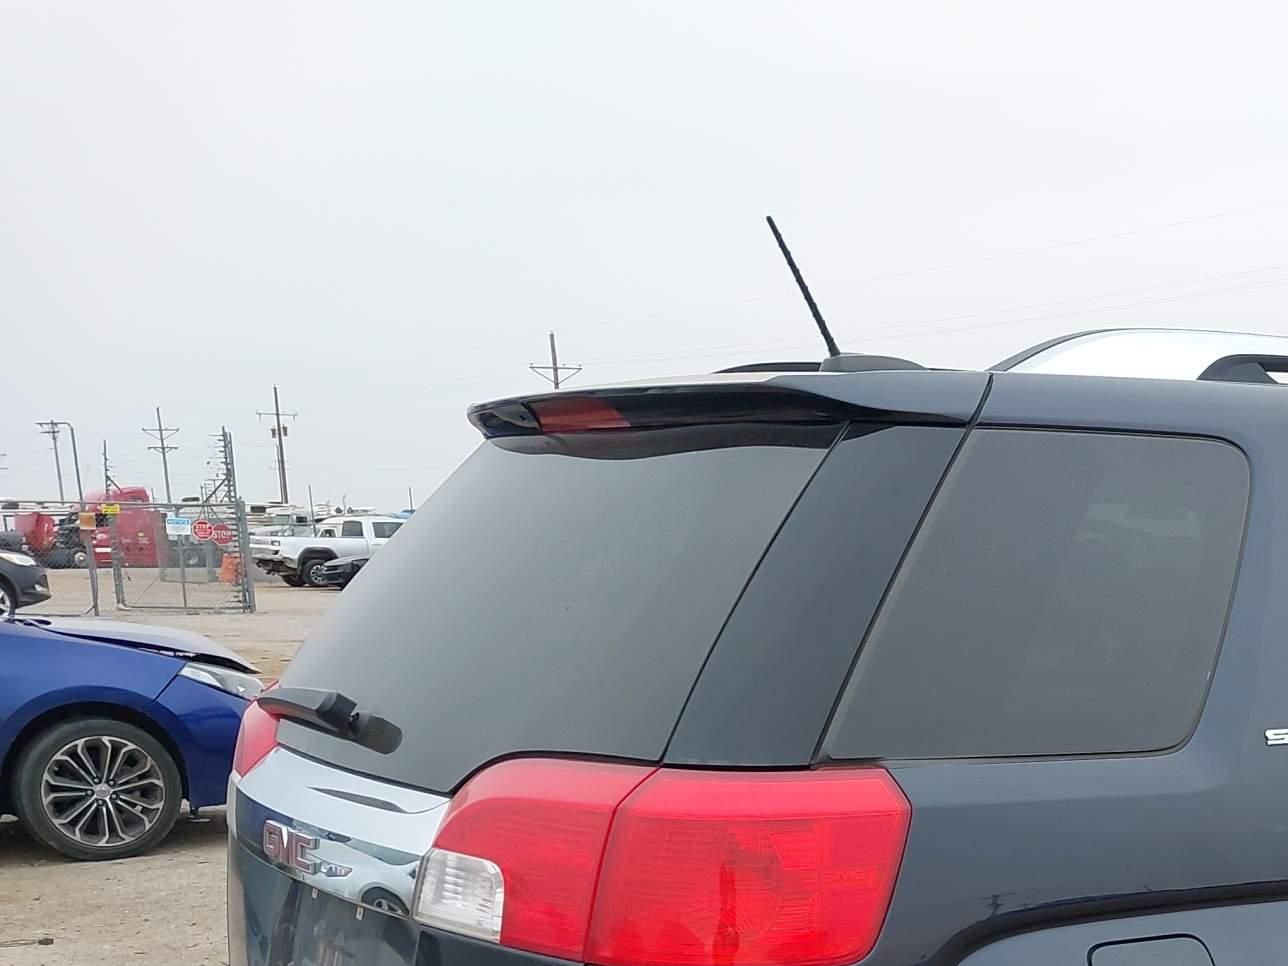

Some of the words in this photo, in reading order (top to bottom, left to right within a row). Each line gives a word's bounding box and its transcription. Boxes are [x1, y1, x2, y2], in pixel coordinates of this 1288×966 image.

[213, 530, 232, 539] STOP
[263, 819, 320, 875] GMC
[820, 870, 872, 883] GMC
